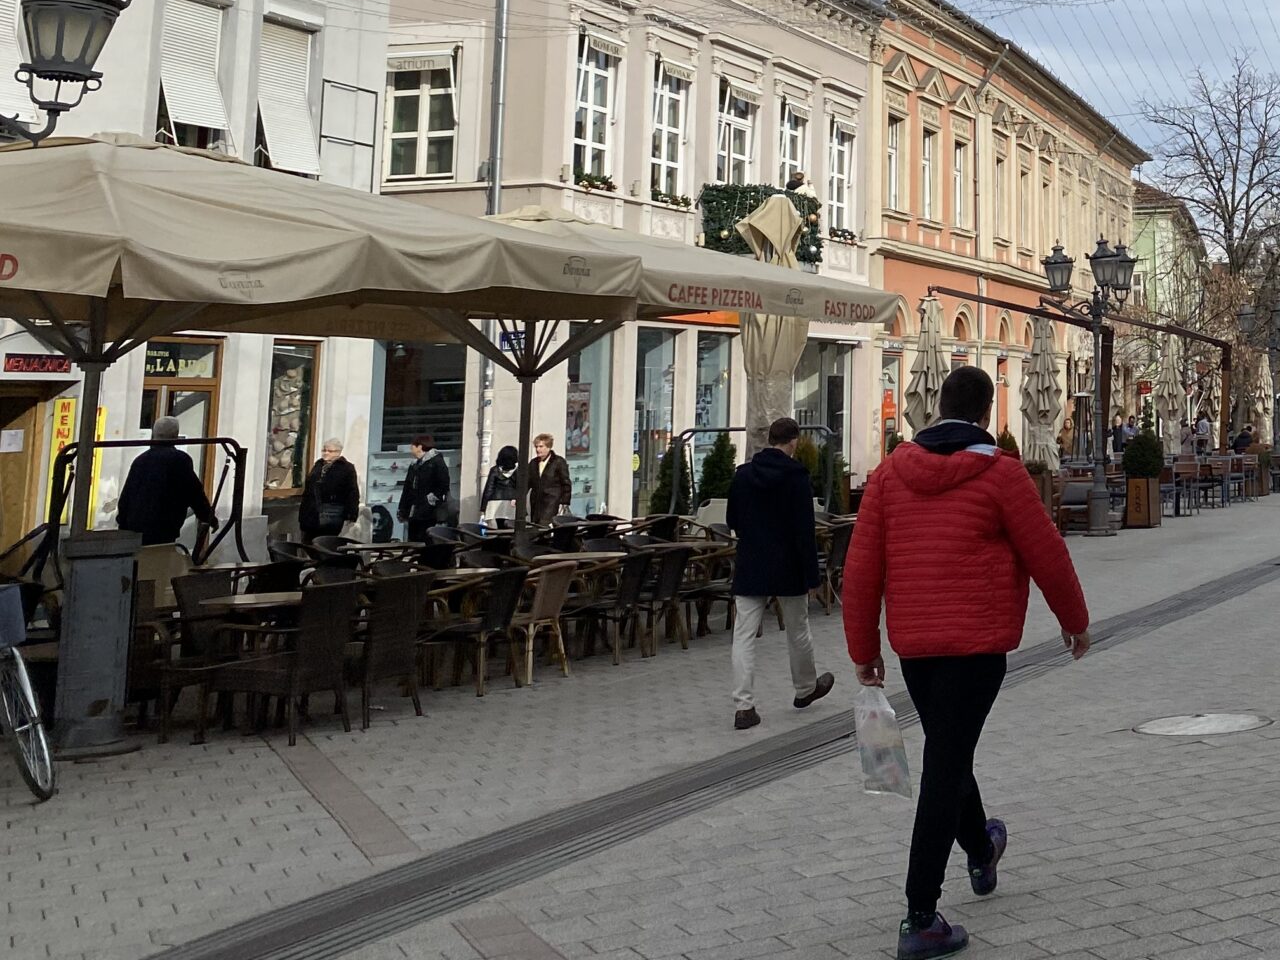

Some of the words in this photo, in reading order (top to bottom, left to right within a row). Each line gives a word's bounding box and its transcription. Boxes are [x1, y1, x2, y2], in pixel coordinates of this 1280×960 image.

[0, 253, 19, 281] D
[668, 283, 708, 305] CAFFE
[711, 287, 763, 310] PIZZERIA
[824, 300, 848, 318] FAST
[850, 303, 876, 320] FOOD
[5, 356, 71, 372] MENJAČNICA
